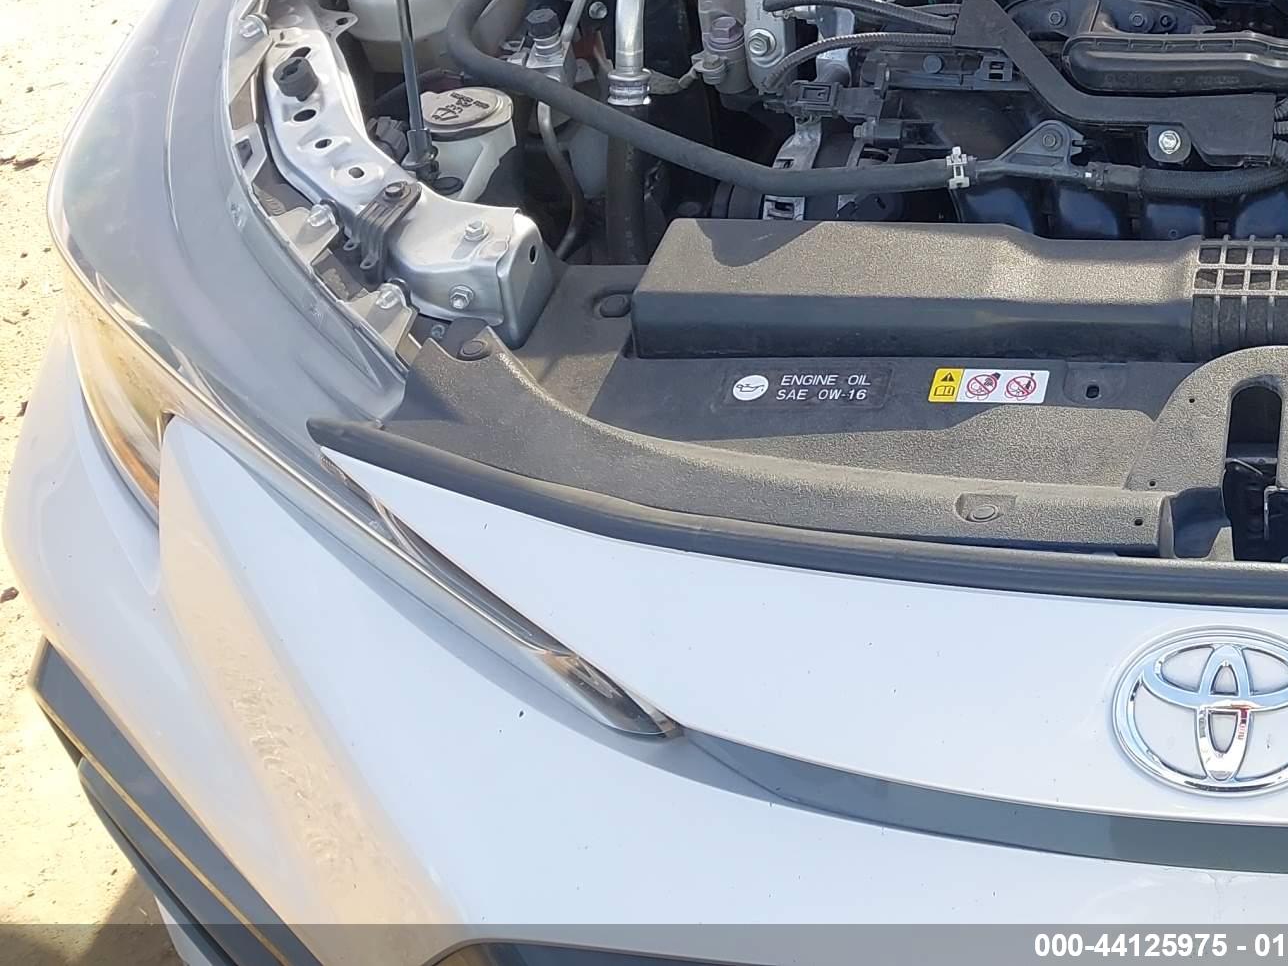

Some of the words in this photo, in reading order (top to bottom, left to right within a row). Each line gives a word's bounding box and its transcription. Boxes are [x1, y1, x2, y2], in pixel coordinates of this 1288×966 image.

[780, 374, 839, 386] ENGINE
[847, 374, 871, 386] OIL
[776, 389, 808, 400] SAE
[818, 389, 867, 400] 0W-16
